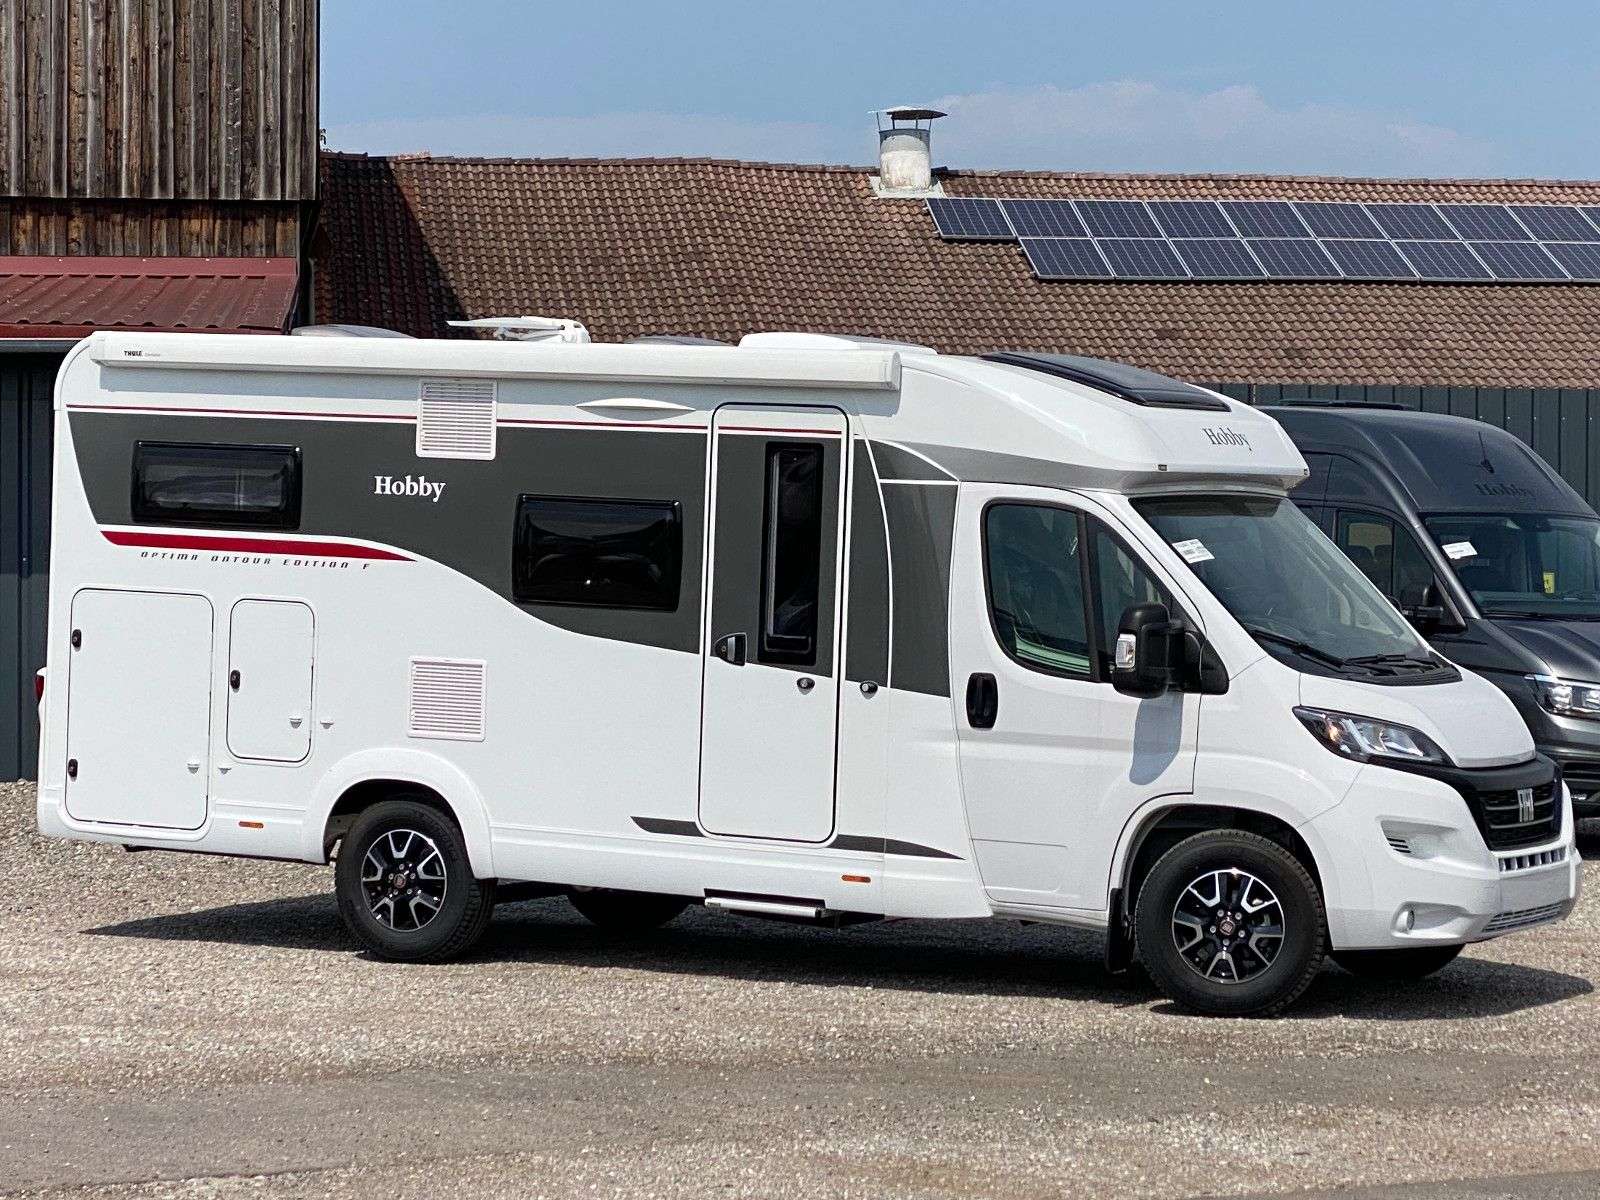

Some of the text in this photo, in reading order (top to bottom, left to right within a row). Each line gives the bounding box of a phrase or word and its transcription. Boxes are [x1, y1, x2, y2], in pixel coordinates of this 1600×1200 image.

[1202, 427, 1252, 451] Hobby
[374, 475, 447, 503] Hobby
[140, 551, 198, 561] OPTIMA
[208, 555, 271, 565] ONTOUR
[283, 559, 349, 569] EDITION
